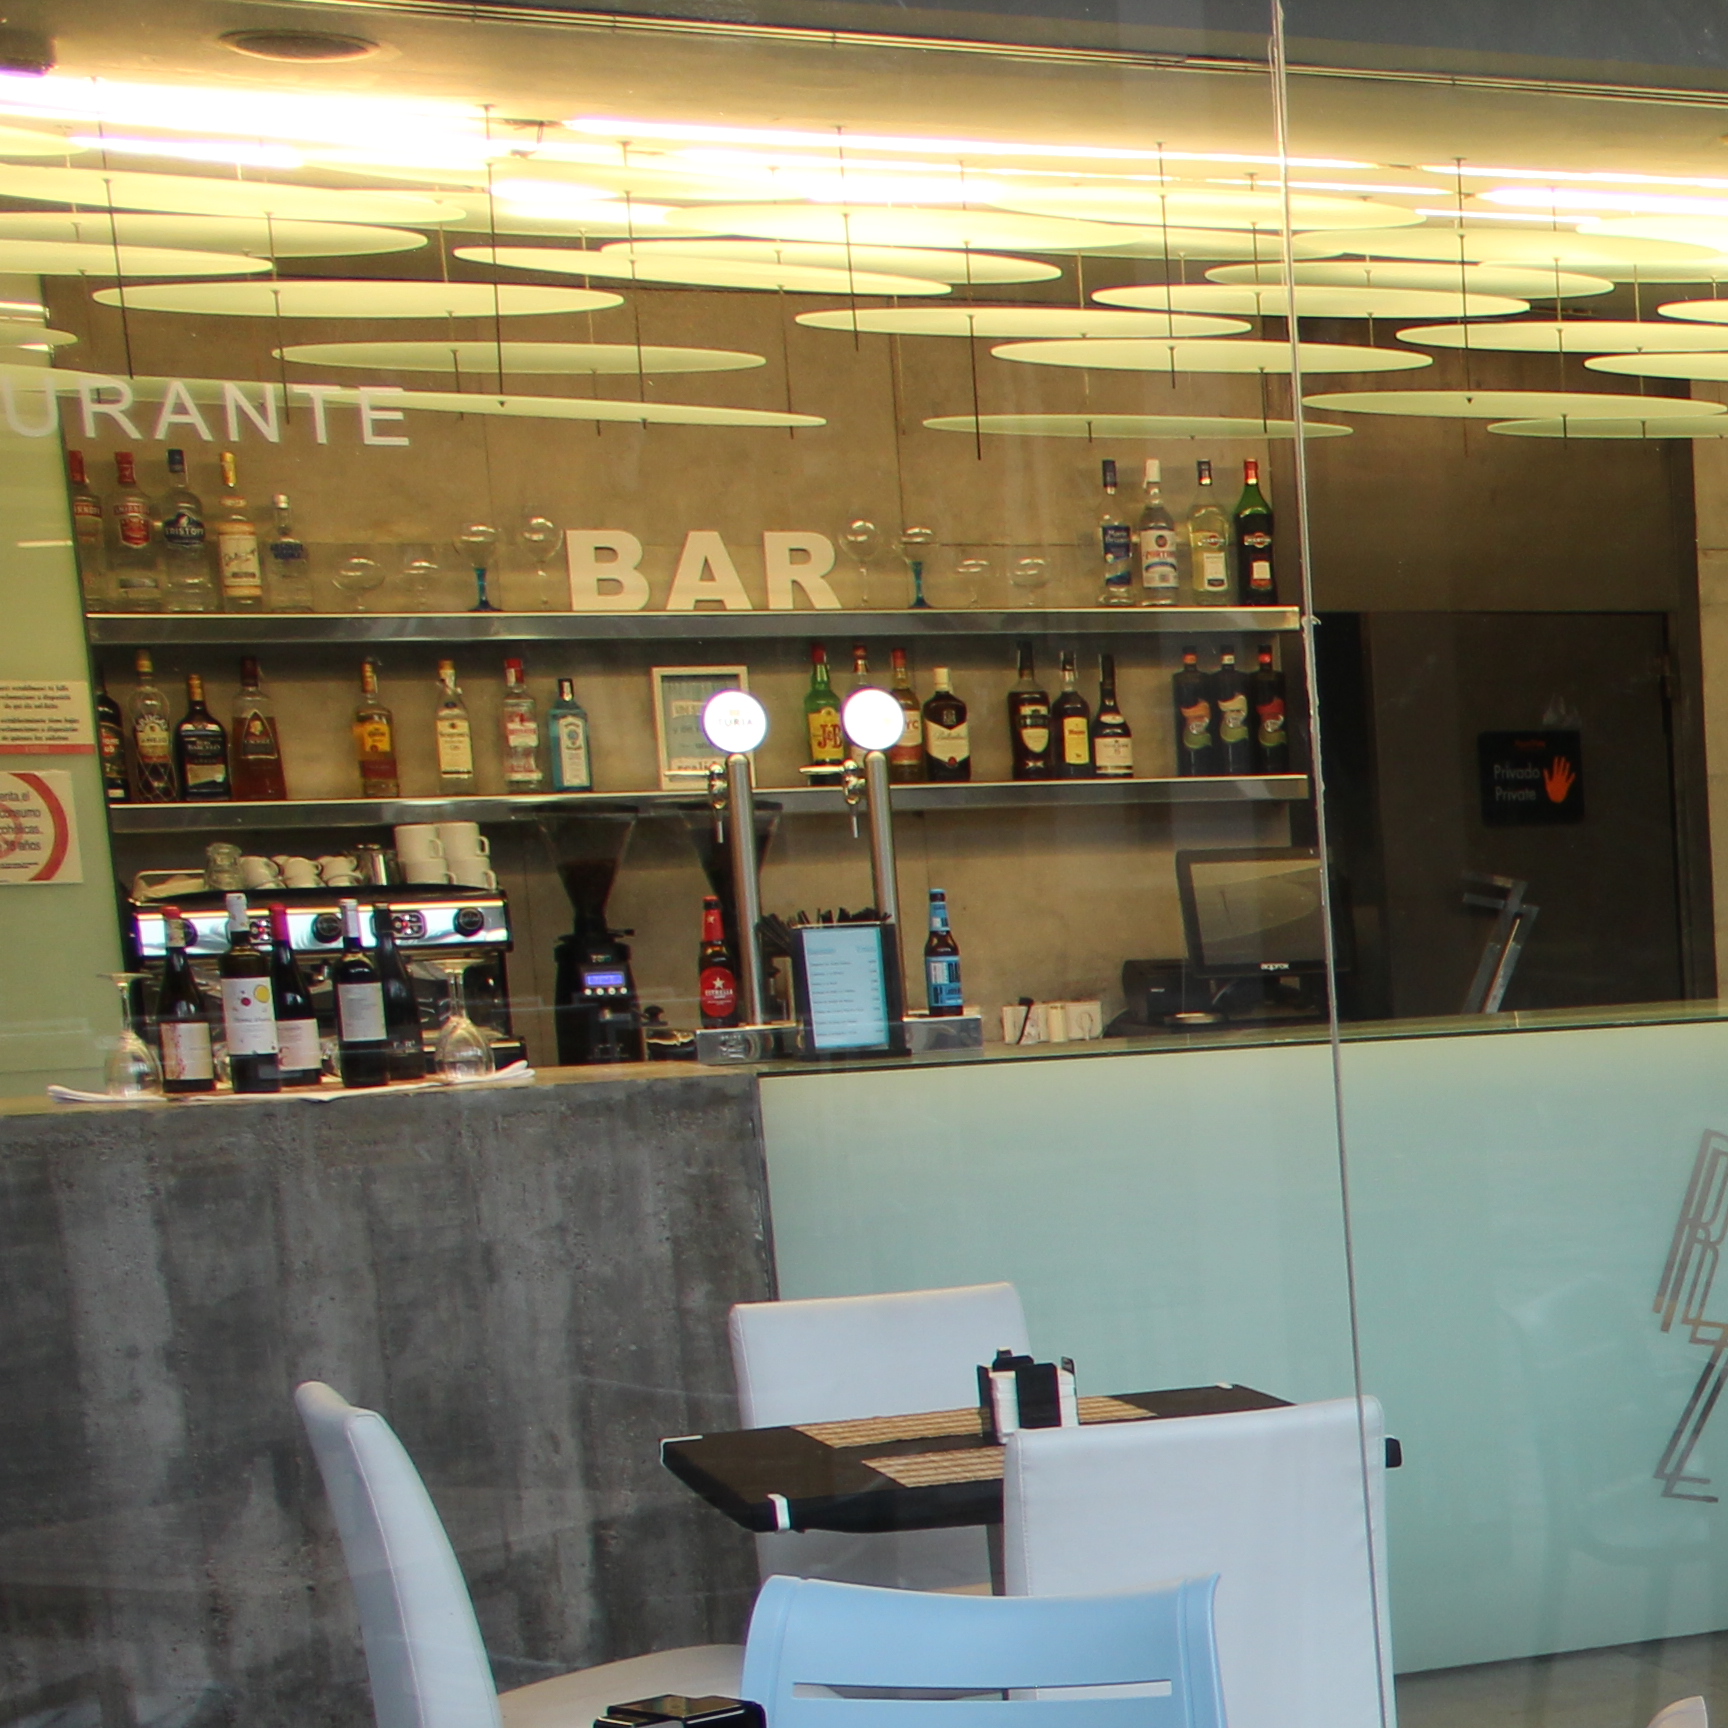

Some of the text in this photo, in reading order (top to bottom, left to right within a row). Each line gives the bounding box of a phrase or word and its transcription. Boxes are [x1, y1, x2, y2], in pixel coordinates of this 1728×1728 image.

[565, 530, 843, 610] BAR
[905, 719, 920, 731] YC
[817, 723, 843, 749] J&B
[1493, 761, 1541, 780] Privado
[1495, 786, 1537, 801] Private
